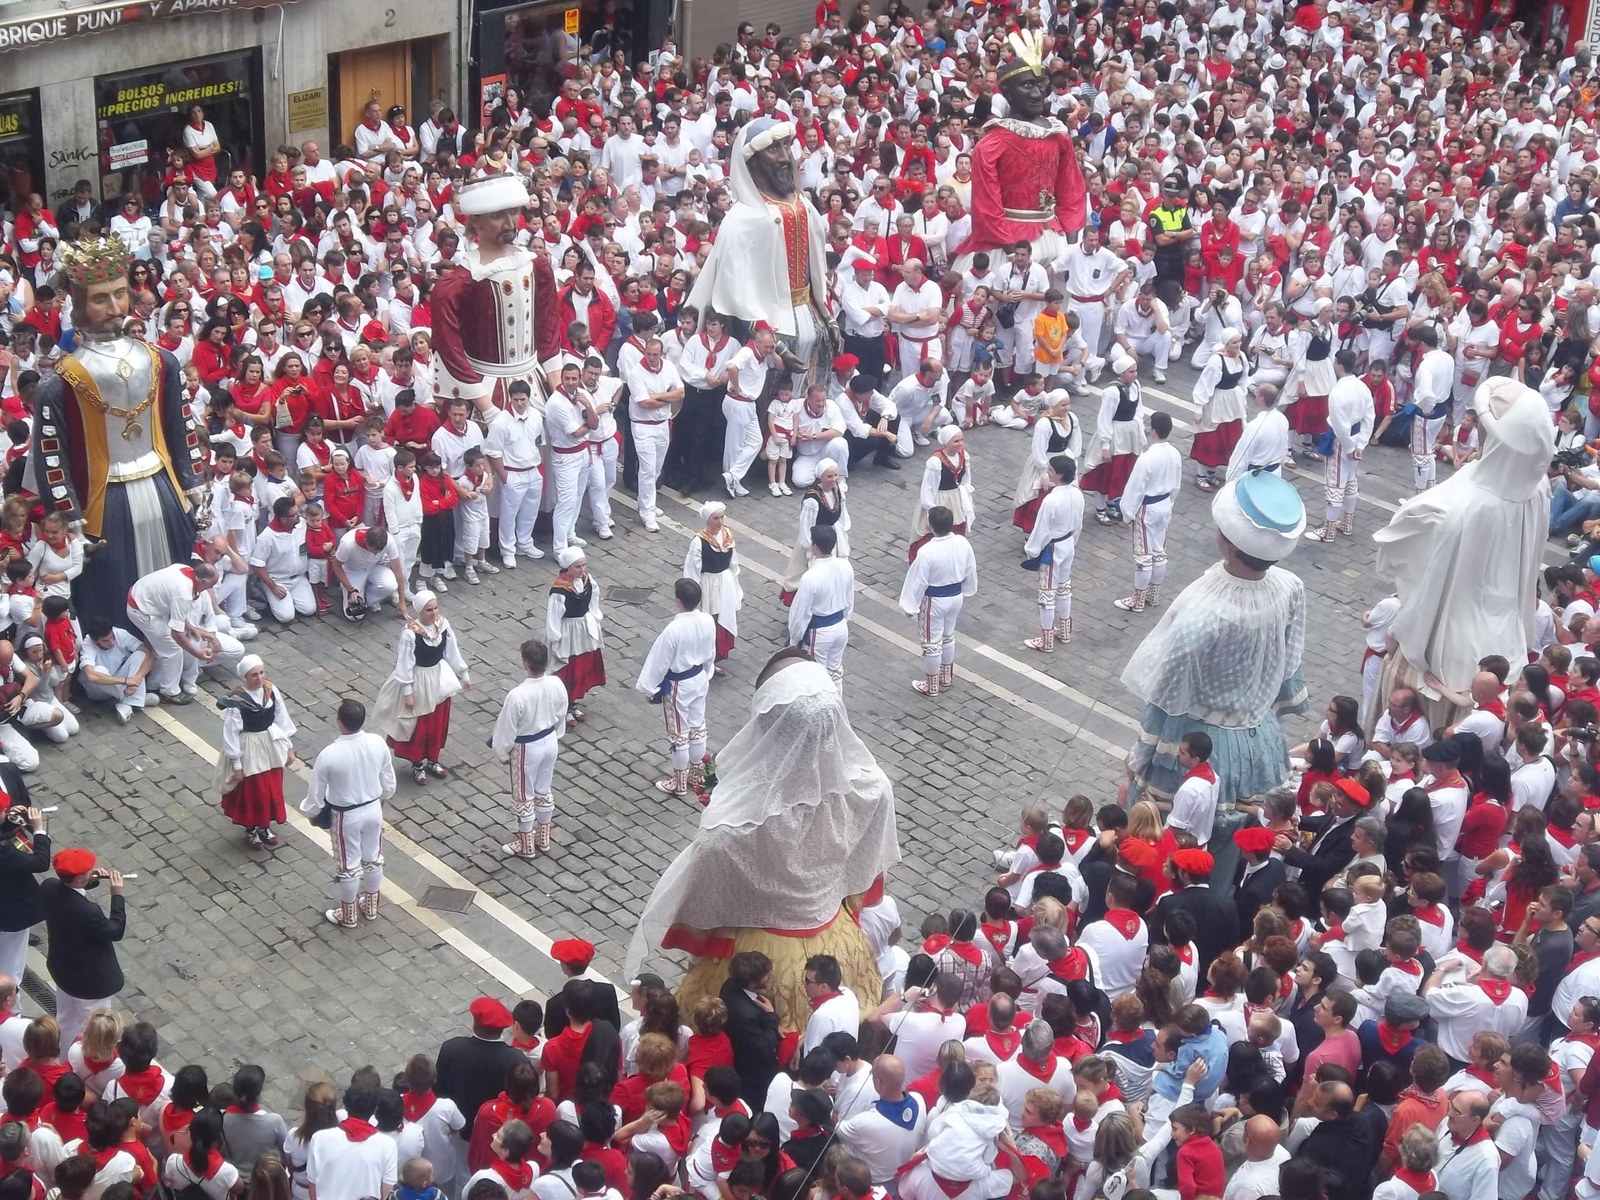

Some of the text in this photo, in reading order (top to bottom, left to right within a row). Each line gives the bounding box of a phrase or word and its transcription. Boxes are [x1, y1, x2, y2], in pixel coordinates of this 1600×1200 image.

[149, 1, 163, 16] Y
[384, 8, 396, 27] 2
[117, 83, 165, 102] BOLSOS
[165, 80, 243, 105] INCREIBLES!!
[293, 91, 321, 103] ELIZARI
